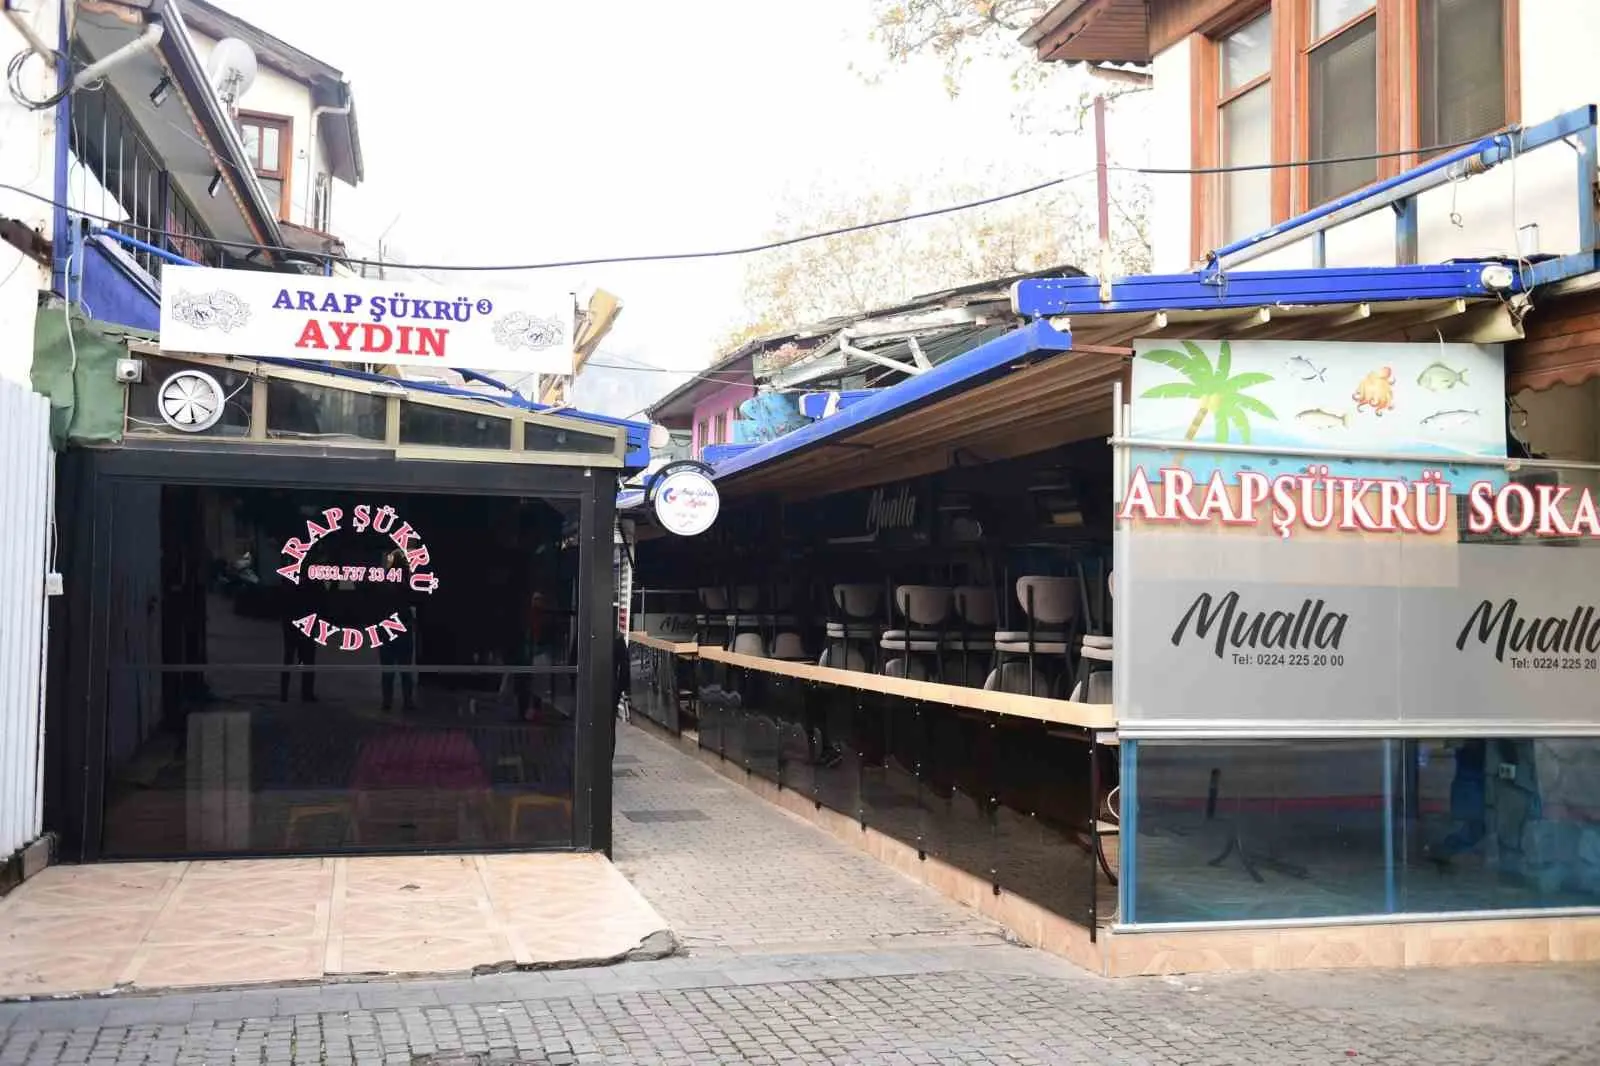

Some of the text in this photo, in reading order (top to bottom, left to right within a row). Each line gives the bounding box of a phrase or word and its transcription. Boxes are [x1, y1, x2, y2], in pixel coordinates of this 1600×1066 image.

[272, 289, 363, 314] ARAP
[369, 292, 474, 323] ŞÜKRÜ
[295, 319, 450, 357] AYDIN
[1119, 465, 1600, 538] ARAPŞÜKRÜ SOKA
[276, 504, 439, 595] ARAP ŞÜKRÜ
[386, 567, 402, 582] 41
[292, 612, 407, 650] AYDIN
[1171, 591, 1348, 659] Mualla
[1232, 654, 1344, 666] Tel: 0224 225 20 00
[1511, 657, 1597, 669] Tel: 0224 225 20
